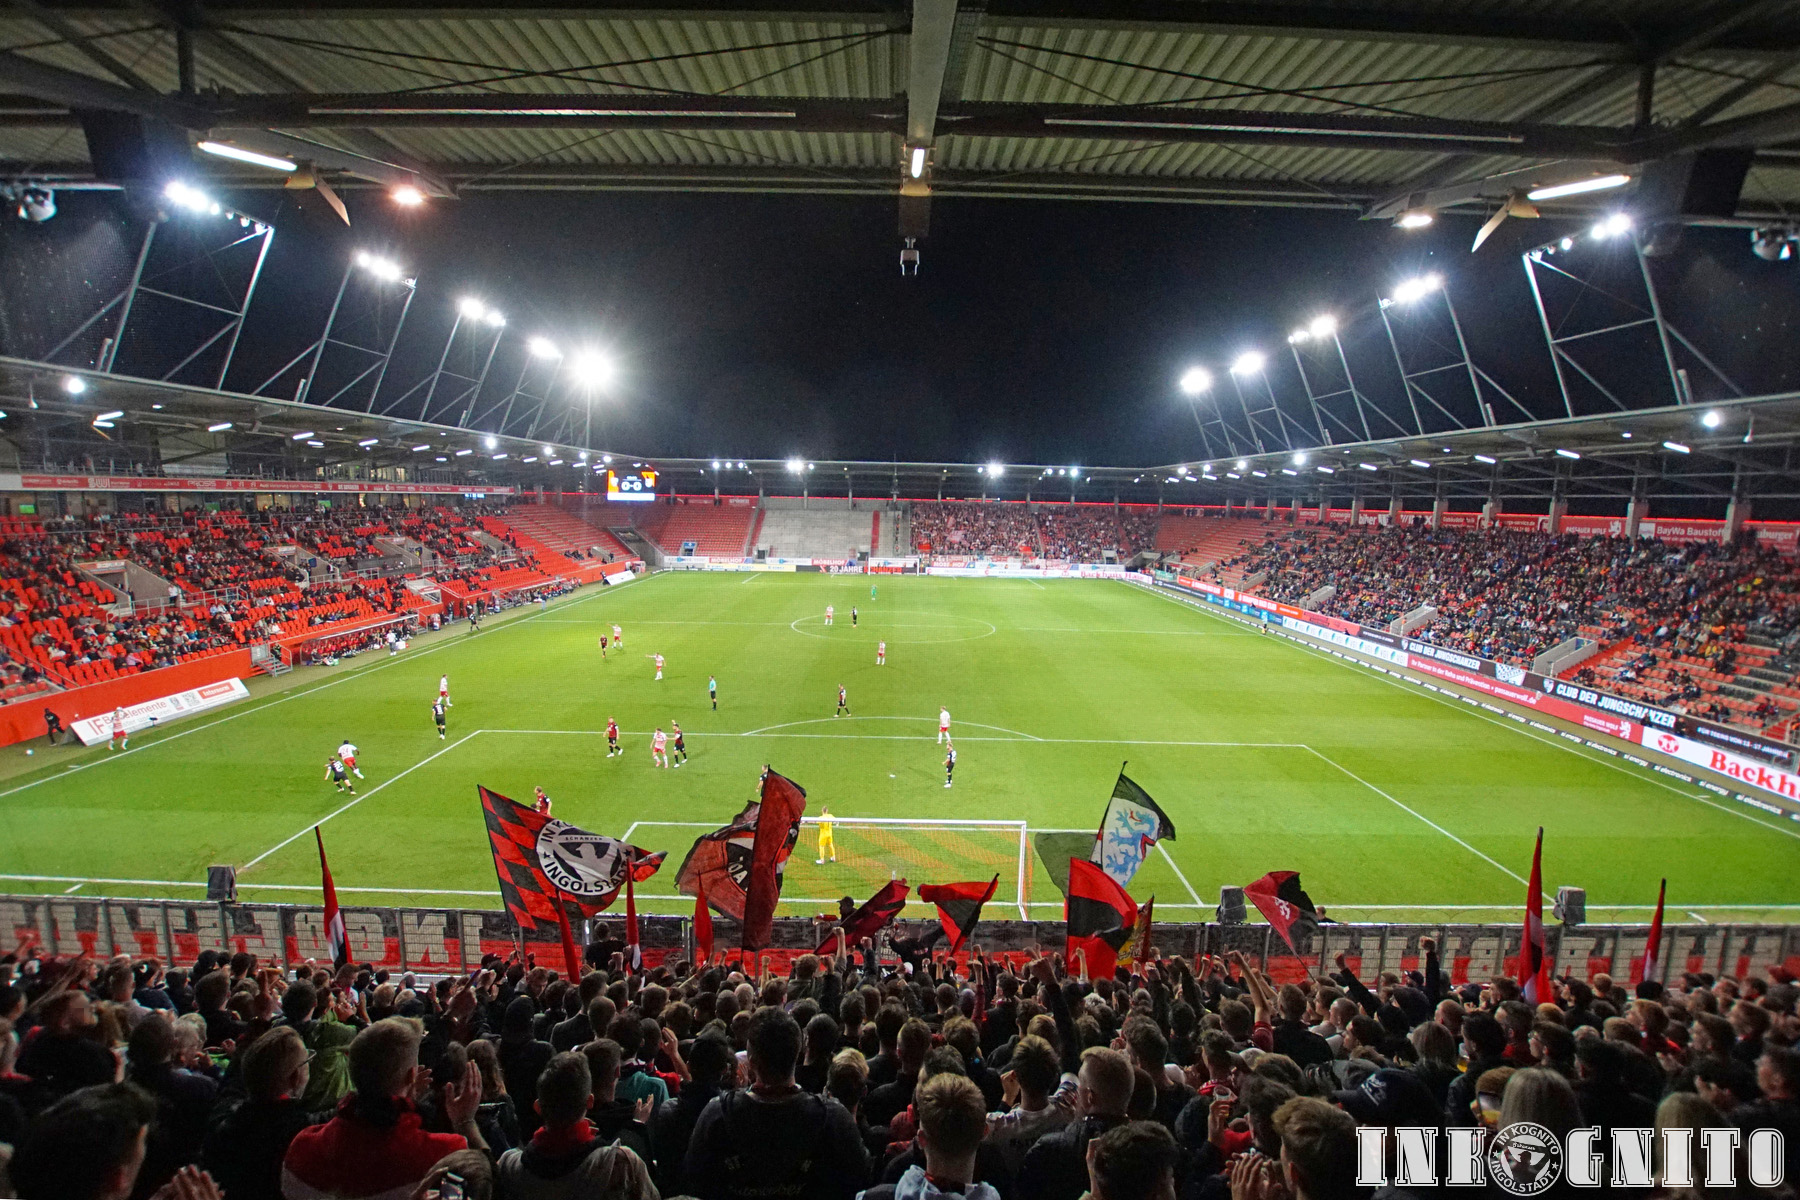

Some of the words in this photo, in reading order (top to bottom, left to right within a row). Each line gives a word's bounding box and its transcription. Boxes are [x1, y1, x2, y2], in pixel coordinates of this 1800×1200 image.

[1656, 526, 1685, 537] BayWa
[1409, 642, 1423, 654] CLUB
[1423, 646, 1436, 656] DER
[1418, 660, 1432, 671] Partner
[1456, 674, 1465, 682] und
[1556, 684, 1578, 700] CLUB
[1578, 689, 1598, 706] DER
[87, 718, 106, 736] IF
[104, 700, 167, 725] Belemente
[1629, 755, 1648, 767] energy
[1660, 766, 1692, 782] electronics
[1710, 750, 1800, 799] Backh
[1706, 783, 1729, 796] energy
[1744, 796, 1783, 815] electronics
